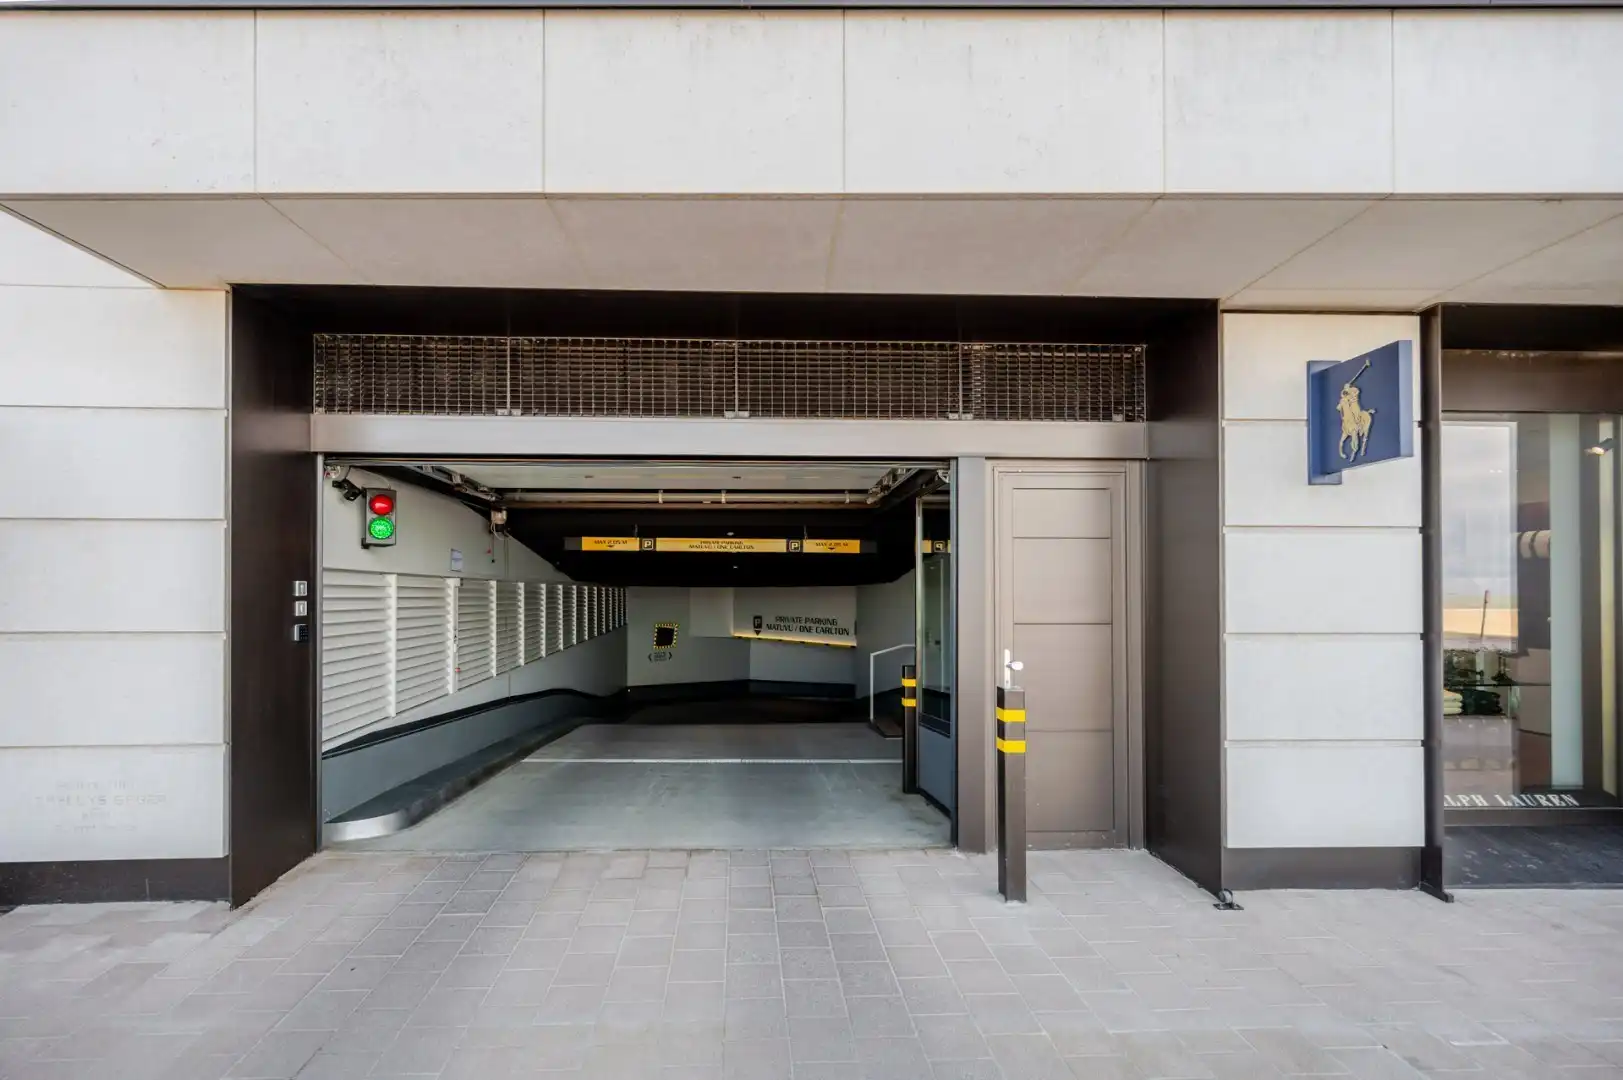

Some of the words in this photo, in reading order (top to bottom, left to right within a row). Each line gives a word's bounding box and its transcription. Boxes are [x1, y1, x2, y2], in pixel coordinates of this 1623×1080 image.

[644, 540, 652, 549] P
[791, 542, 799, 550] P
[775, 615, 803, 625] PRIVATE
[804, 617, 838, 627] PARKING
[799, 625, 814, 633] ONE
[815, 626, 850, 636] CARLTON
[1444, 794, 1489, 807] LPH
[1494, 794, 1580, 807] LAUREN
